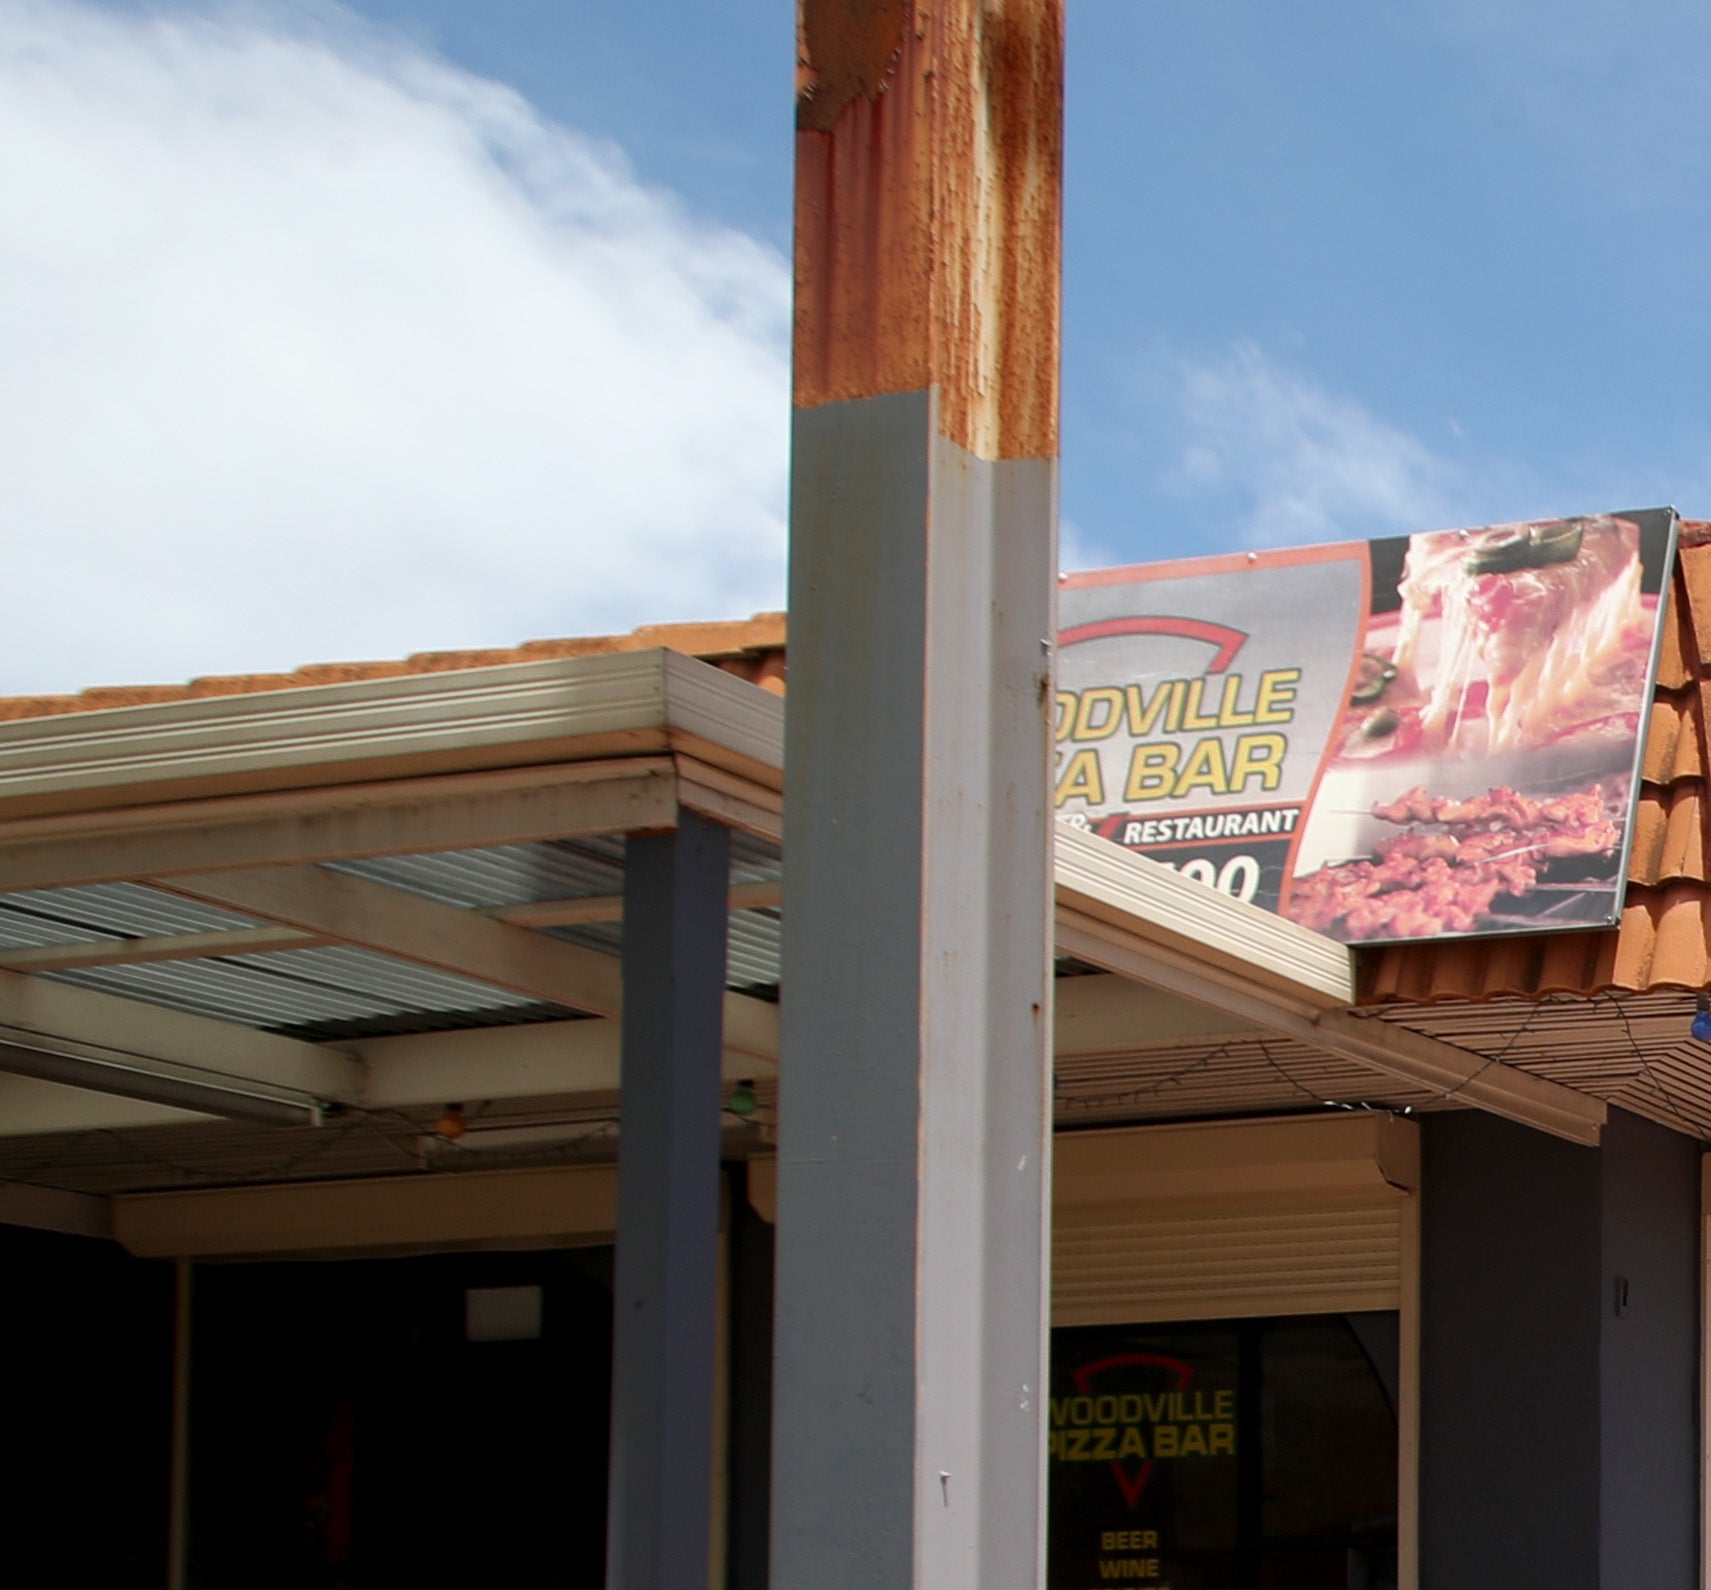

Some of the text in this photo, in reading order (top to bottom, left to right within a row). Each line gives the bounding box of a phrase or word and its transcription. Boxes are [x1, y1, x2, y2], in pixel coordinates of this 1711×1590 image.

[1123, 732, 1288, 803] BAR
[1124, 809, 1300, 844] RESTAURANT
[1050, 1422, 1237, 1461] IZZA BAR
[1100, 1530, 1159, 1551] BEER
[1099, 1558, 1160, 1579] WINE
